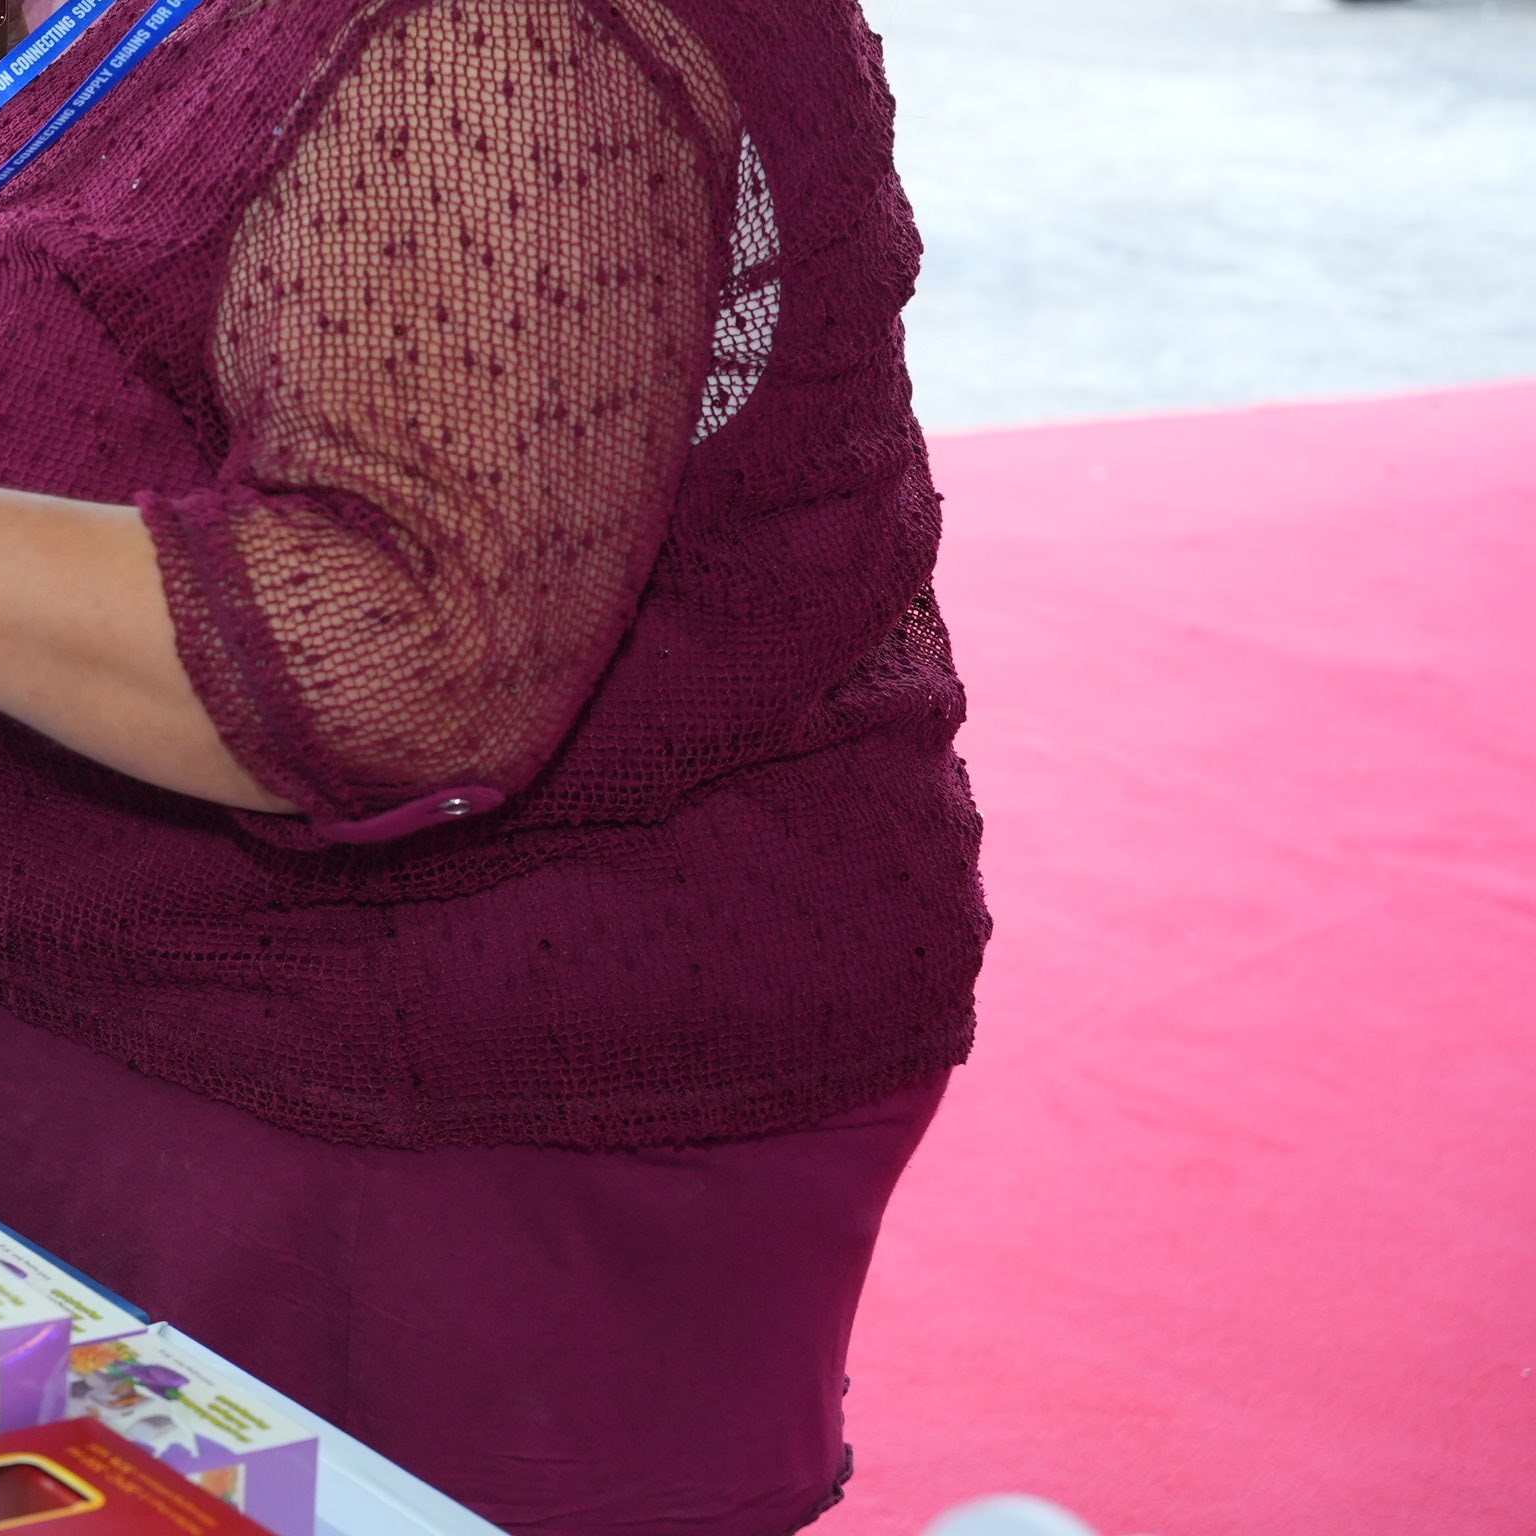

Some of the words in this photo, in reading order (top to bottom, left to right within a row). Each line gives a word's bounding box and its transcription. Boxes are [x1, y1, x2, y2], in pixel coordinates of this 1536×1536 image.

[9, 14, 76, 76] CONNECTING
[13, 107, 76, 165] CONNECTING
[73, 67, 114, 108] SUPPLY
[109, 28, 151, 69] CHAINS
[145, 5, 173, 31] FOR
